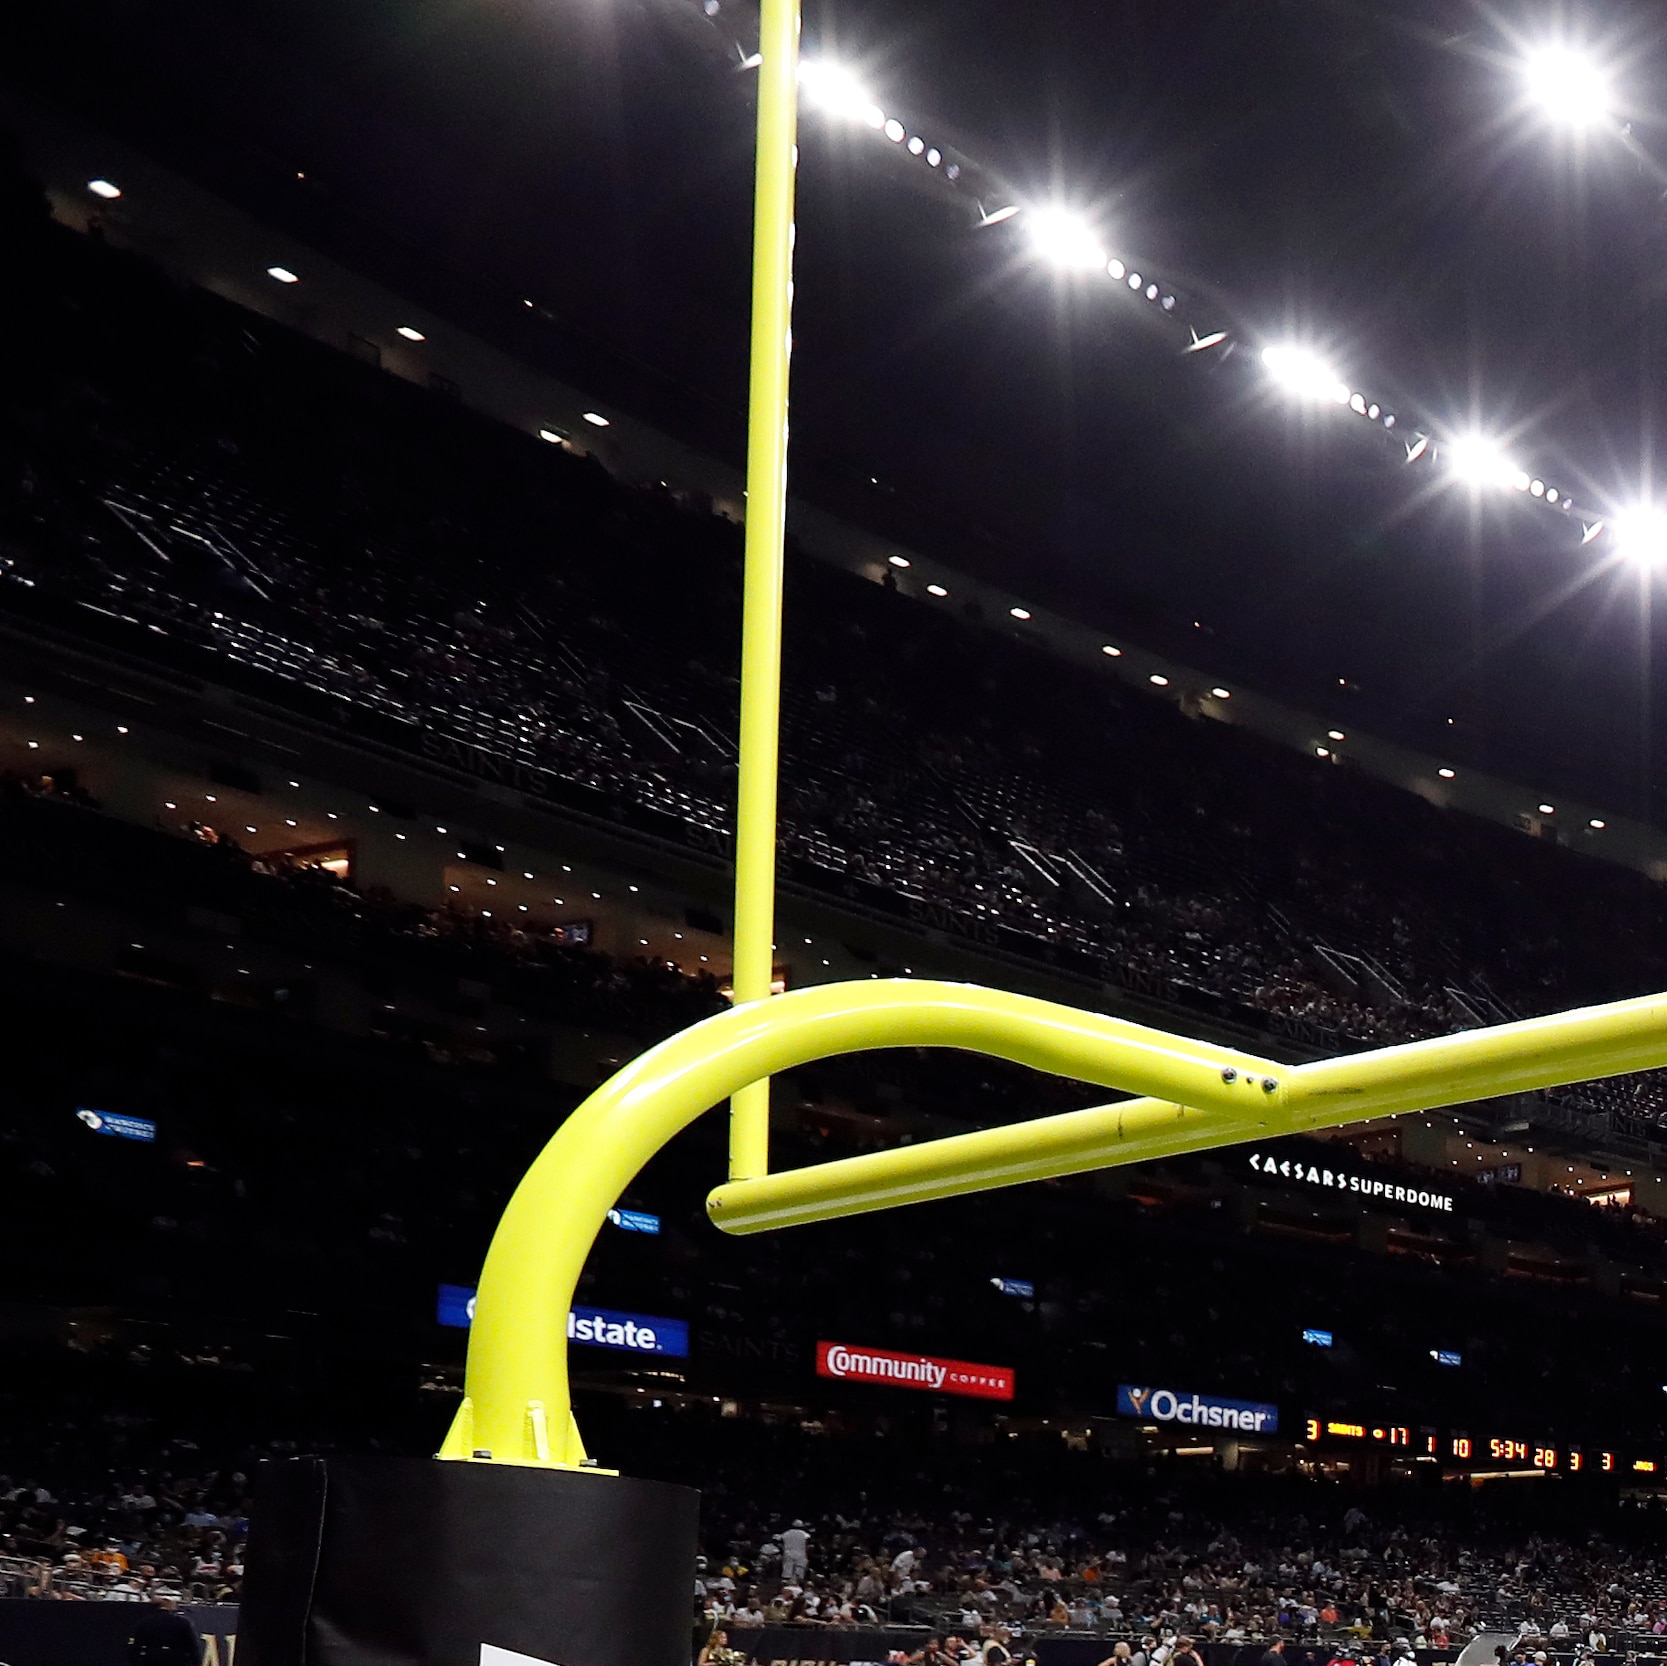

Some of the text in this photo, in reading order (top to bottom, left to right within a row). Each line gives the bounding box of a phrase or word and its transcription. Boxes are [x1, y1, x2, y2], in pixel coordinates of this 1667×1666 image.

[1248, 1153, 1454, 1212] CAESARS SUPERDOME
[826, 1345, 1006, 1389] Community COFFEE
[1150, 1389, 1266, 1432] Ochsner
[1307, 1419, 1322, 1442] 3
[1390, 1427, 1410, 1446] 17
[1452, 1438, 1473, 1459] 10
[1490, 1438, 1529, 1461] 5:34
[1533, 1447, 1559, 1469] 28
